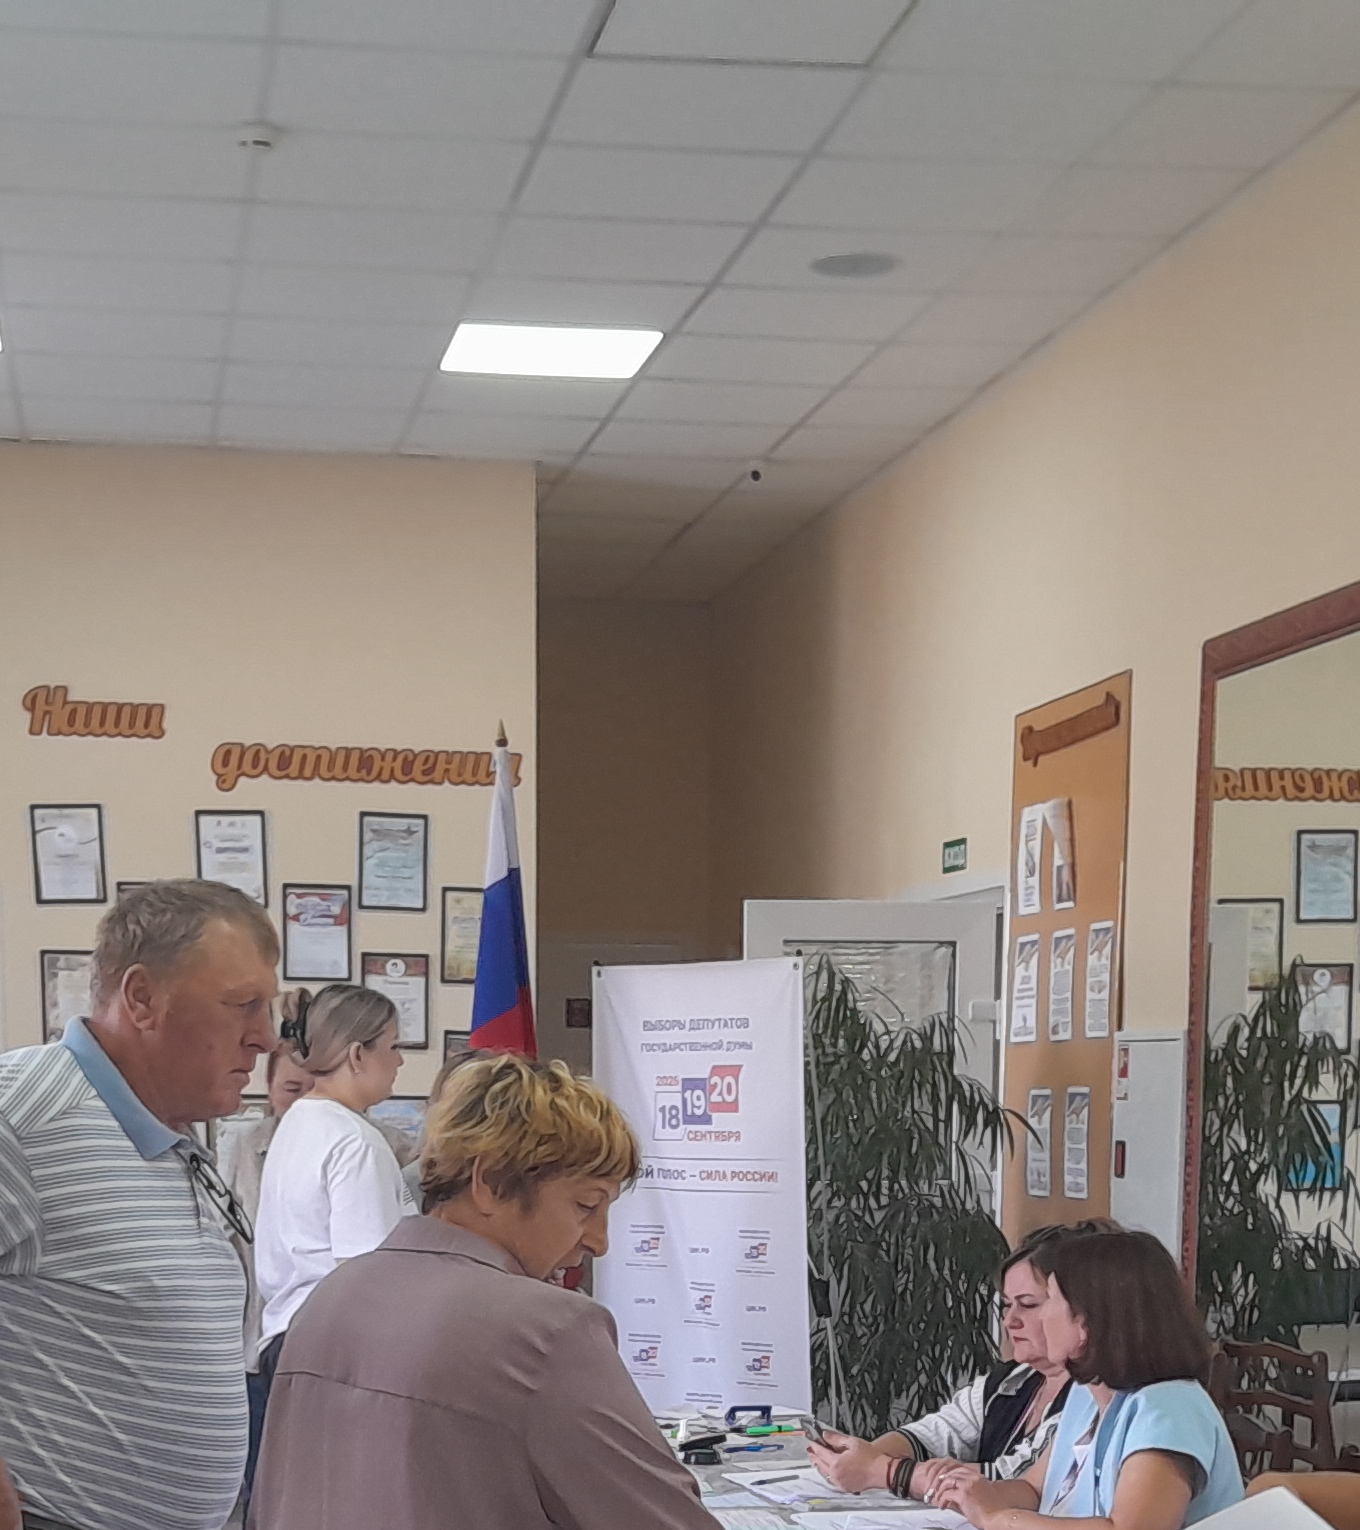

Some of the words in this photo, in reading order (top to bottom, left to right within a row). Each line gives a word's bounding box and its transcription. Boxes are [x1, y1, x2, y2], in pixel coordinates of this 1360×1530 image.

[22, 685, 165, 739] Наши
[658, 1104, 680, 1129] 18
[684, 1089, 706, 1116] 19
[709, 1075, 737, 1103] 20
